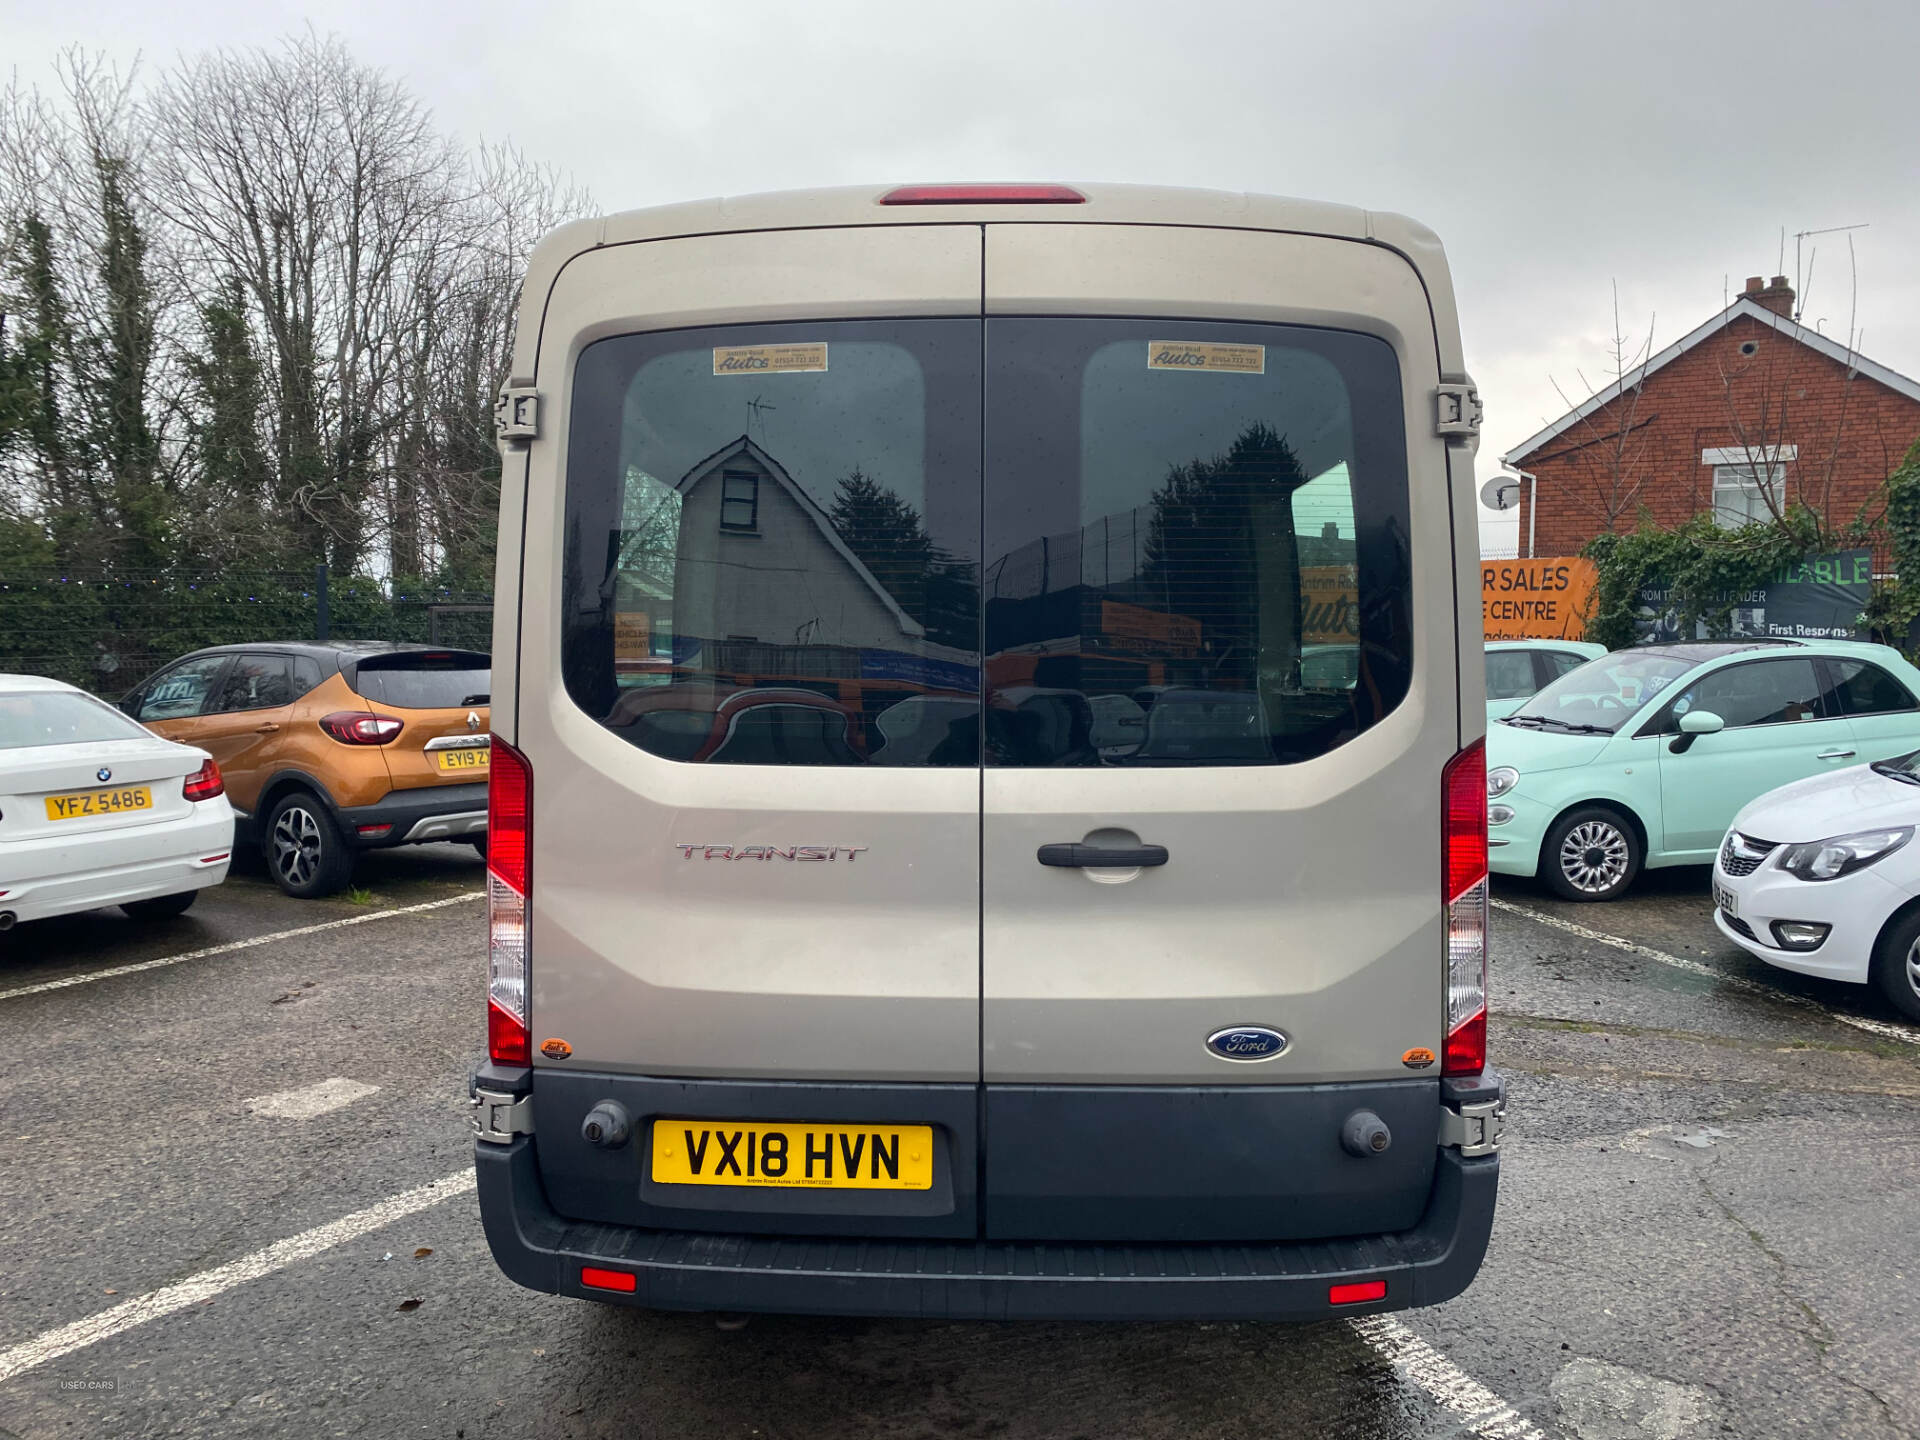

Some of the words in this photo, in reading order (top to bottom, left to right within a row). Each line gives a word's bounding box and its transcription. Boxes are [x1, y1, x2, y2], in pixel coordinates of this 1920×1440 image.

[719, 356, 770, 370] Autos
[1153, 351, 1207, 366] Autos
[1500, 566, 1570, 591] SALES
[1641, 590, 1661, 601] ROM
[1490, 600, 1557, 621] CENTRE
[1769, 623, 1793, 635] First
[446, 752, 475, 767] EY19
[54, 796, 93, 816] YFZ
[98, 790, 145, 810] 5486
[676, 842, 869, 862] TRANSIT
[1226, 1034, 1270, 1051] Ford
[684, 1130, 788, 1177] VX18
[805, 1133, 899, 1179] HVN
